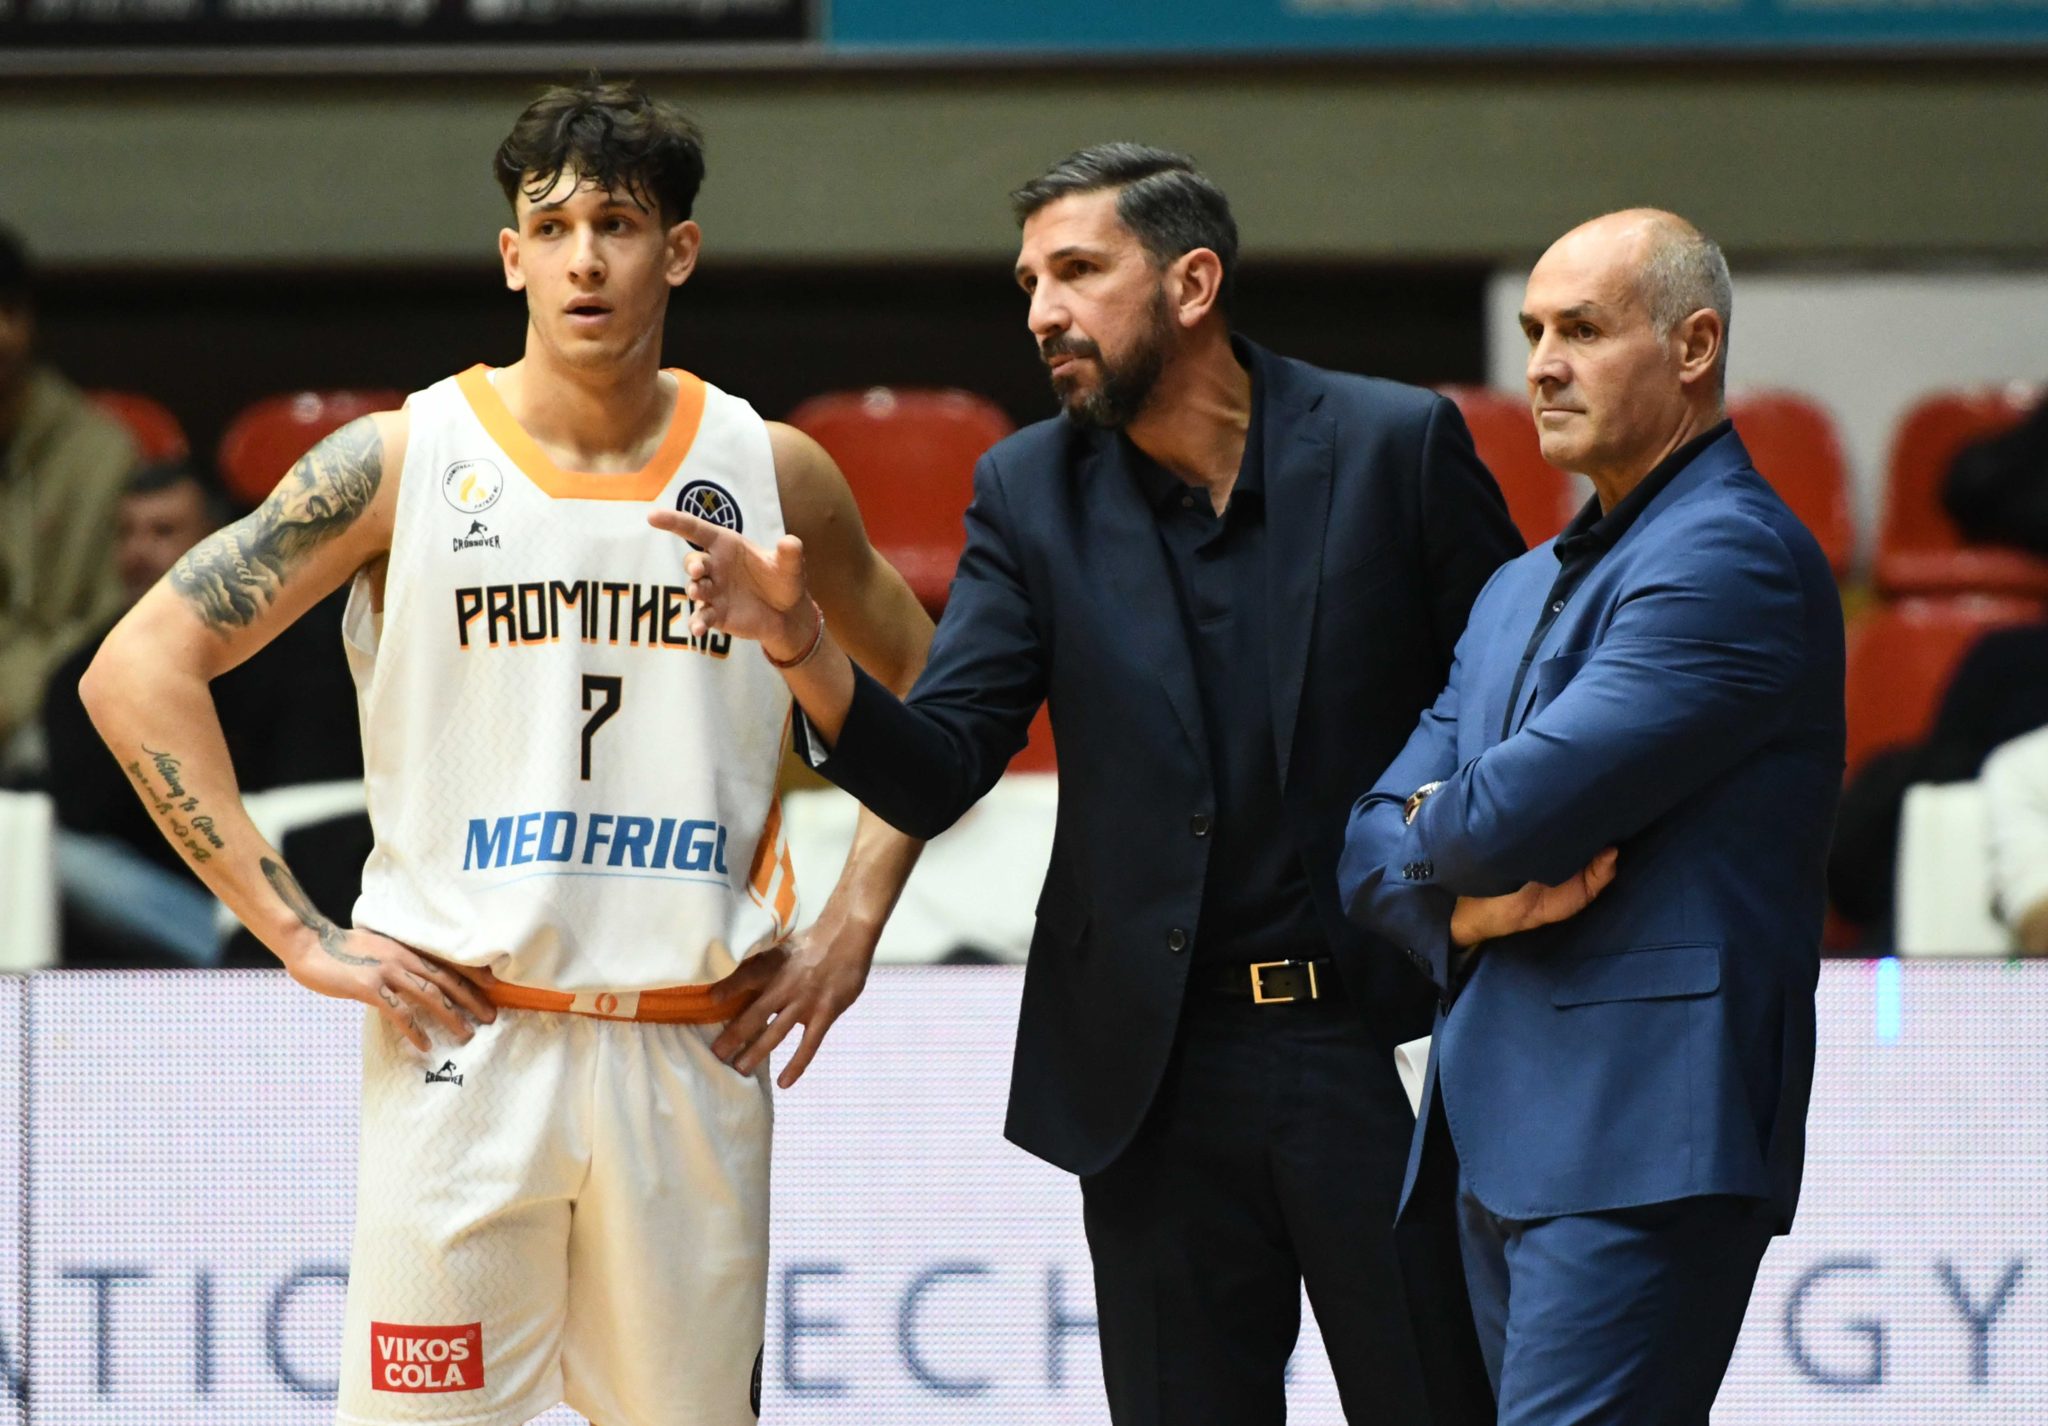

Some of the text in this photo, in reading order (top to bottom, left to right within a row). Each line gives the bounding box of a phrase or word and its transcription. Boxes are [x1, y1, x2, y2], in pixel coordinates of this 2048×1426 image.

[453, 535, 501, 552] CROSSOVER
[581, 673, 623, 781] 7
[462, 811, 577, 871] MED
[0, 1256, 350, 1402] TIC
[377, 1335, 470, 1362] VIKOS
[384, 1362, 466, 1388] COLA
